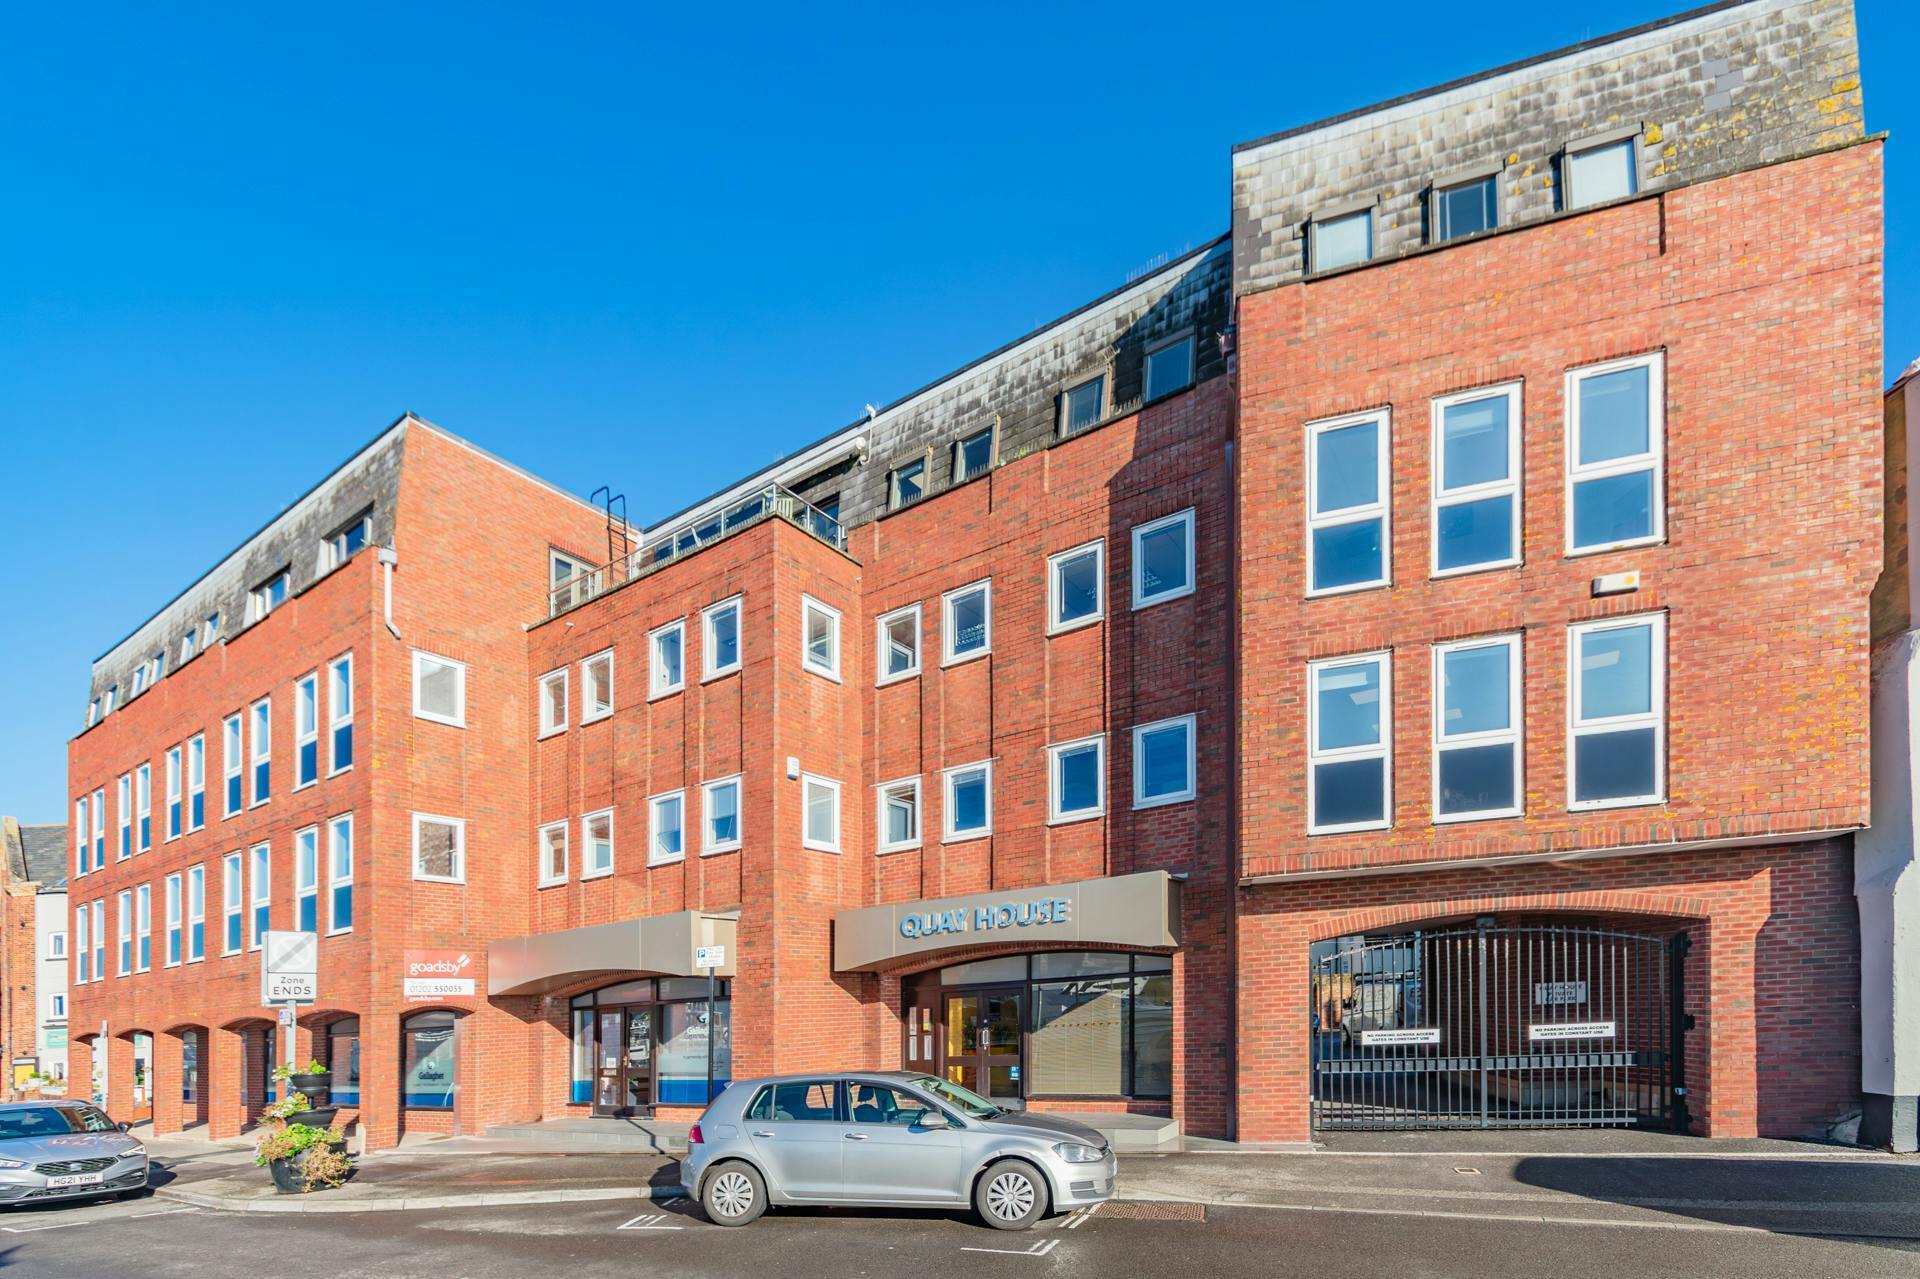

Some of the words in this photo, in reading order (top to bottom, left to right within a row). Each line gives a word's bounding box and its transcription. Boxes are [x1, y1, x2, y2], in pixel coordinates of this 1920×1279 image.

[900, 906, 969, 939] QUAY
[974, 897, 1067, 931] HOUSE
[410, 960, 461, 976] goadsby
[280, 976, 305, 984] Zone
[273, 986, 312, 995] ENDS
[53, 1176, 76, 1185] HG21
[79, 1174, 97, 1182] YHH
